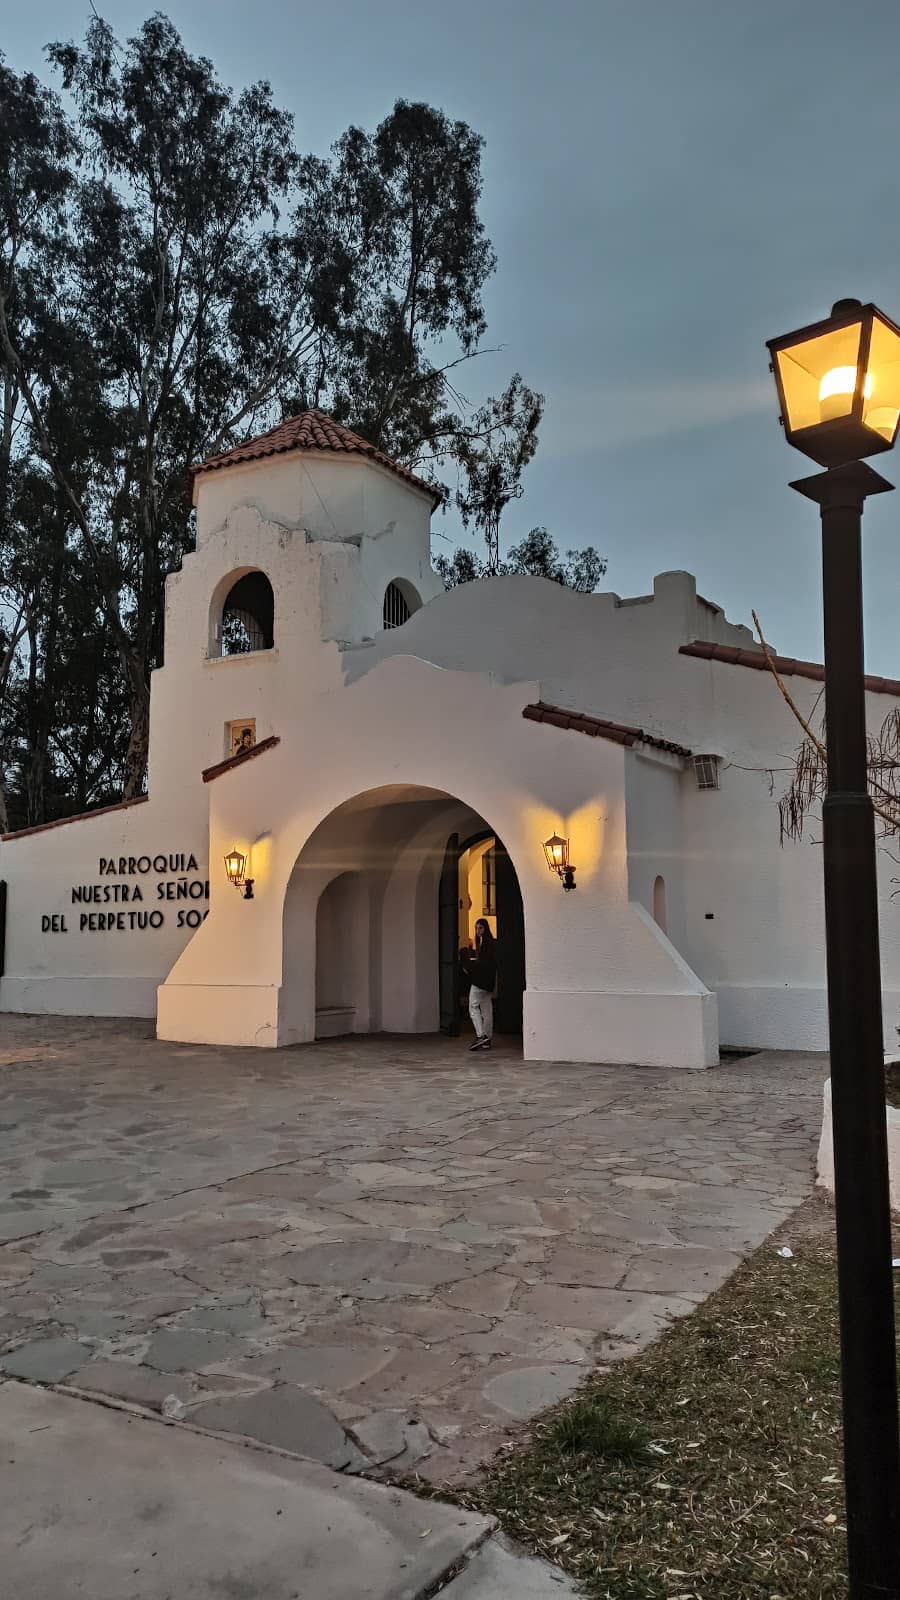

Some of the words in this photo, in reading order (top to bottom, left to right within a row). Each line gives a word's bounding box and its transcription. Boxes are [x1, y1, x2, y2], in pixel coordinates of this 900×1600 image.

[99, 853, 199, 875] PARROQUIA
[71, 884, 143, 904] NUESTRA
[41, 914, 68, 933] DEL
[79, 910, 165, 932] PERPETUO
